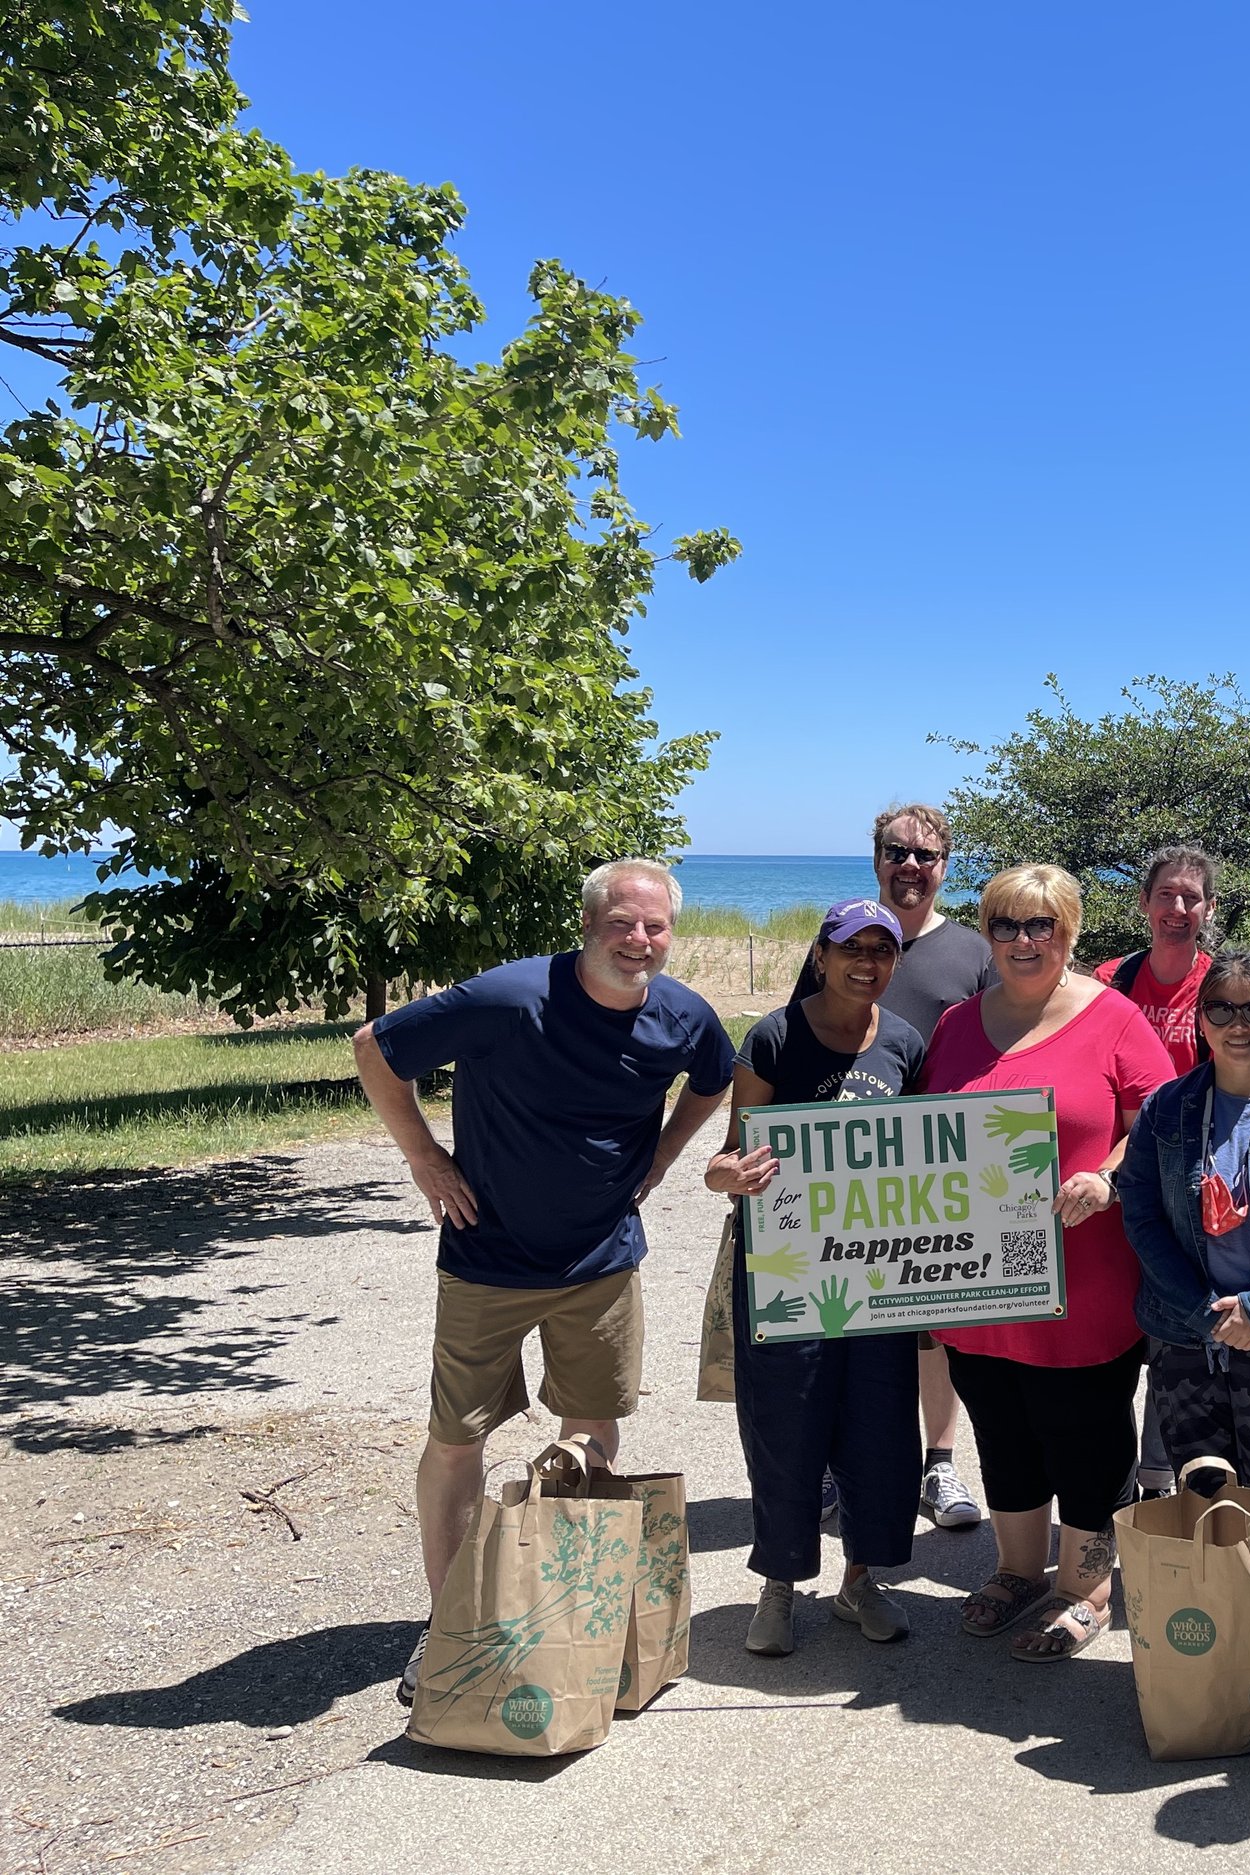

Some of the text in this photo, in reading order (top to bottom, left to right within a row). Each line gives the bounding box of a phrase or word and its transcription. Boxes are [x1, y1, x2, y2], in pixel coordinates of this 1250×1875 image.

[768, 1112, 967, 1175] PITCH IN
[772, 1187, 802, 1212] for
[808, 1171, 970, 1233] PARKS
[999, 1203, 1032, 1213] Chicago
[778, 1211, 801, 1230] the
[1016, 1210, 1037, 1219] Parks
[819, 1232, 975, 1265] happens
[898, 1253, 992, 1285] here!
[879, 1296, 914, 1306] CITYWIDE
[915, 1292, 960, 1302] VOLUNTEER
[961, 1290, 981, 1299] PARK
[982, 1287, 1019, 1297] CLEAN-UP
[1020, 1285, 1048, 1294] EFFORT
[907, 1299, 1050, 1317] chicagoparksfoundation.org/volunteer
[1171, 1621, 1211, 1632] WHOLE
[1173, 1631, 1210, 1642] FOODS
[508, 1700, 548, 1712] WHOLE
[509, 1711, 546, 1723] FOODS
